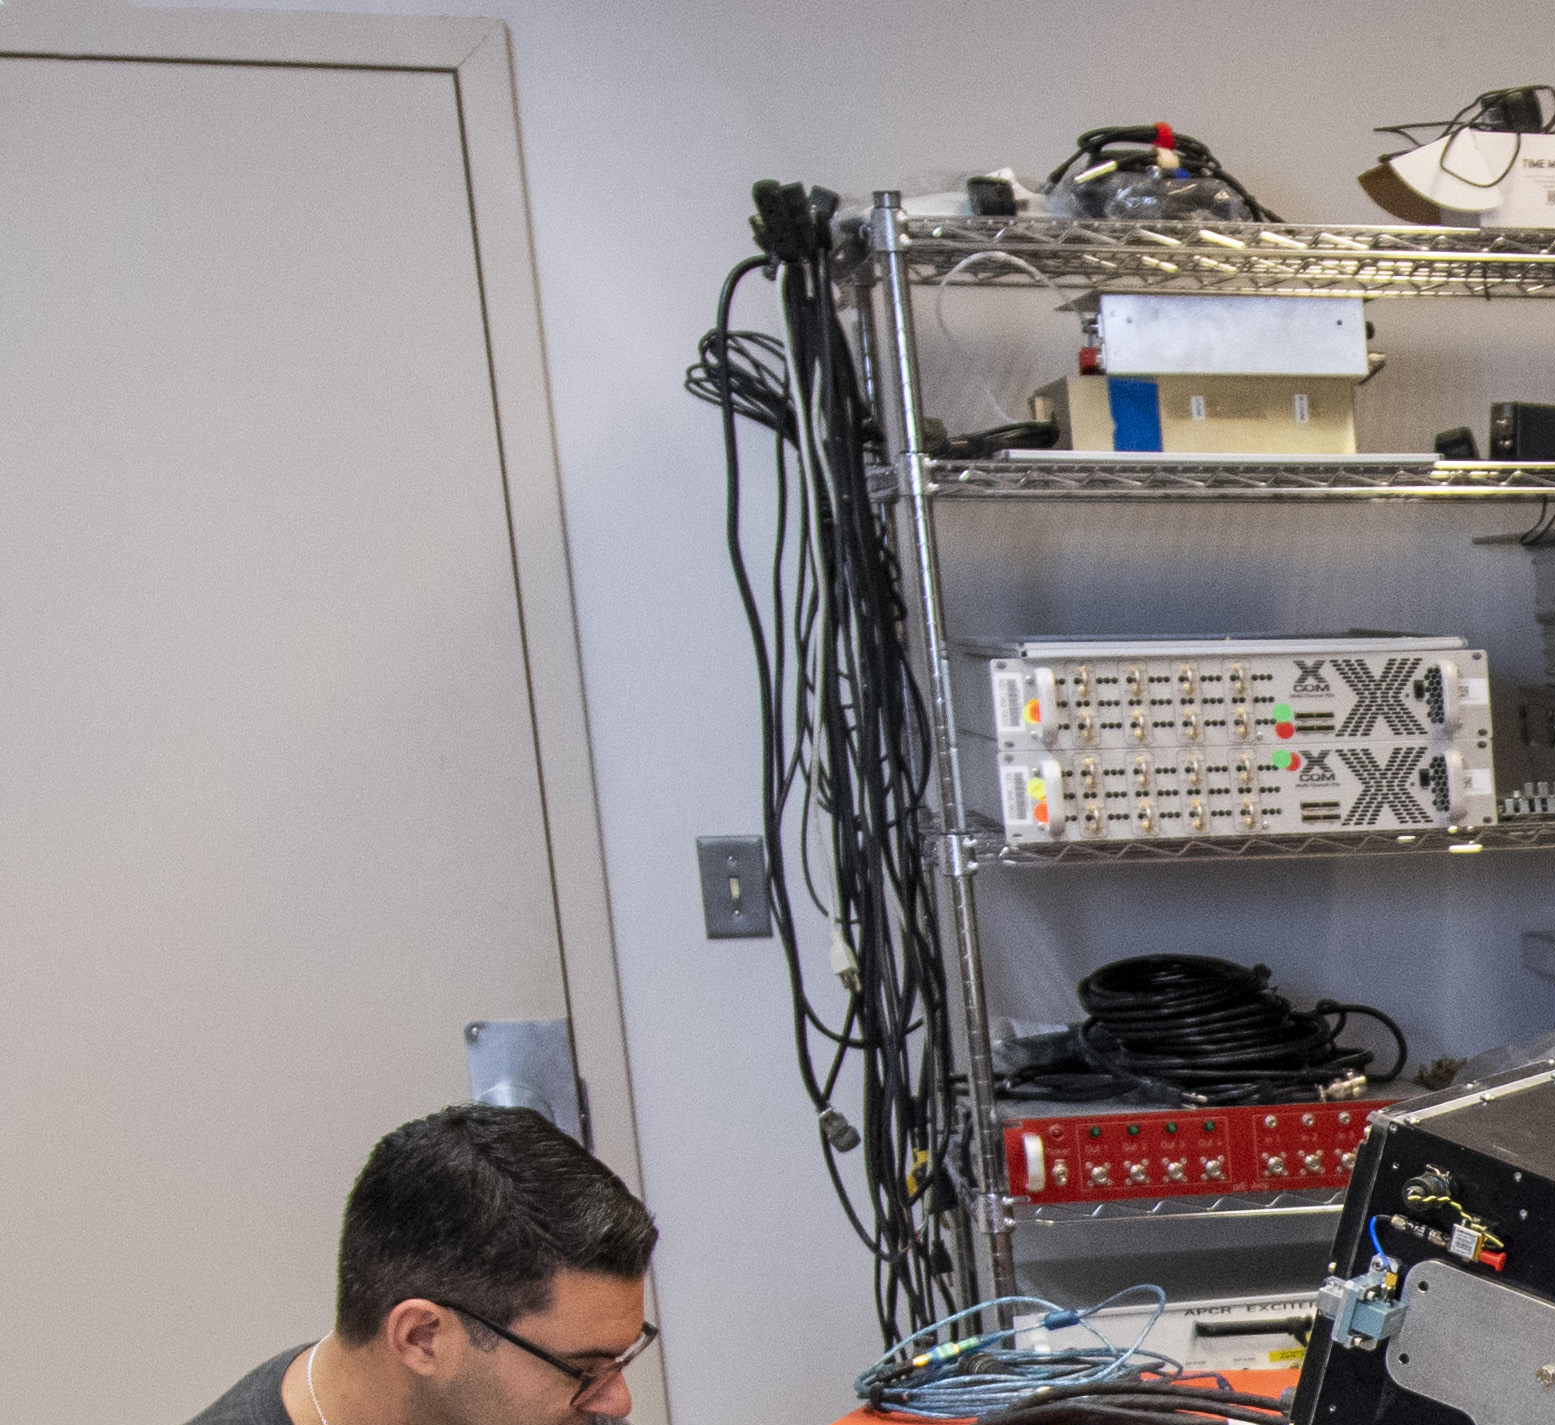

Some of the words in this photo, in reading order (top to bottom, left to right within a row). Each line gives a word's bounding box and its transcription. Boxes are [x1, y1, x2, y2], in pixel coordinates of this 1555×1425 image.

[1294, 684, 1330, 692] COM
[1300, 773, 1336, 782] COM
[1184, 1306, 1232, 1317] APCR
